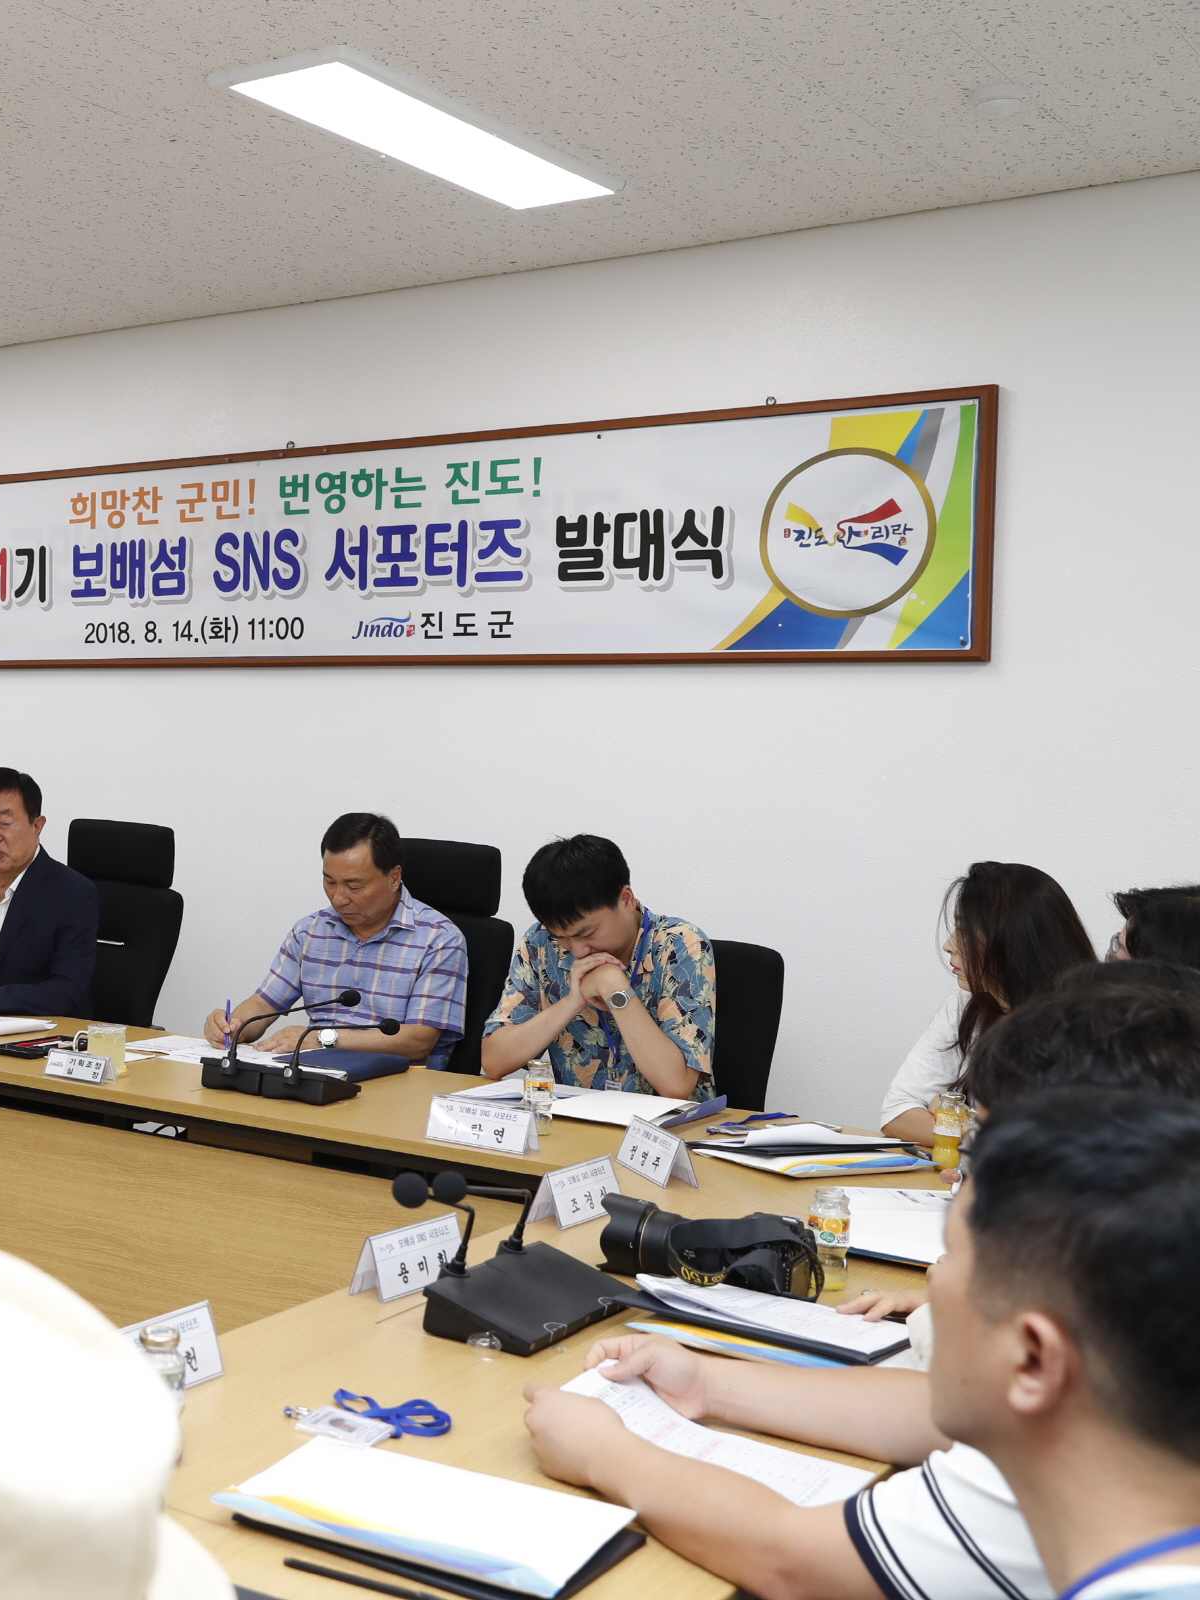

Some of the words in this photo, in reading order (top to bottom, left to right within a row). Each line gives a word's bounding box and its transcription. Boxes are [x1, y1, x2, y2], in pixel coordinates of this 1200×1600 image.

[68, 486, 163, 530] 희망찬
[176, 478, 256, 524] 군민!
[279, 466, 427, 516] 번영하는
[444, 456, 542, 505] 진도!
[70, 536, 187, 600] 보배섬
[212, 528, 301, 593] SNS
[324, 518, 524, 591] 서포터즈
[555, 505, 725, 582] 발대식
[84, 621, 136, 644] 2018.
[144, 620, 163, 644] 8.
[247, 616, 305, 641] 11:00
[351, 620, 405, 640] Jindo
[479, 1109, 491, 1118] SNS
